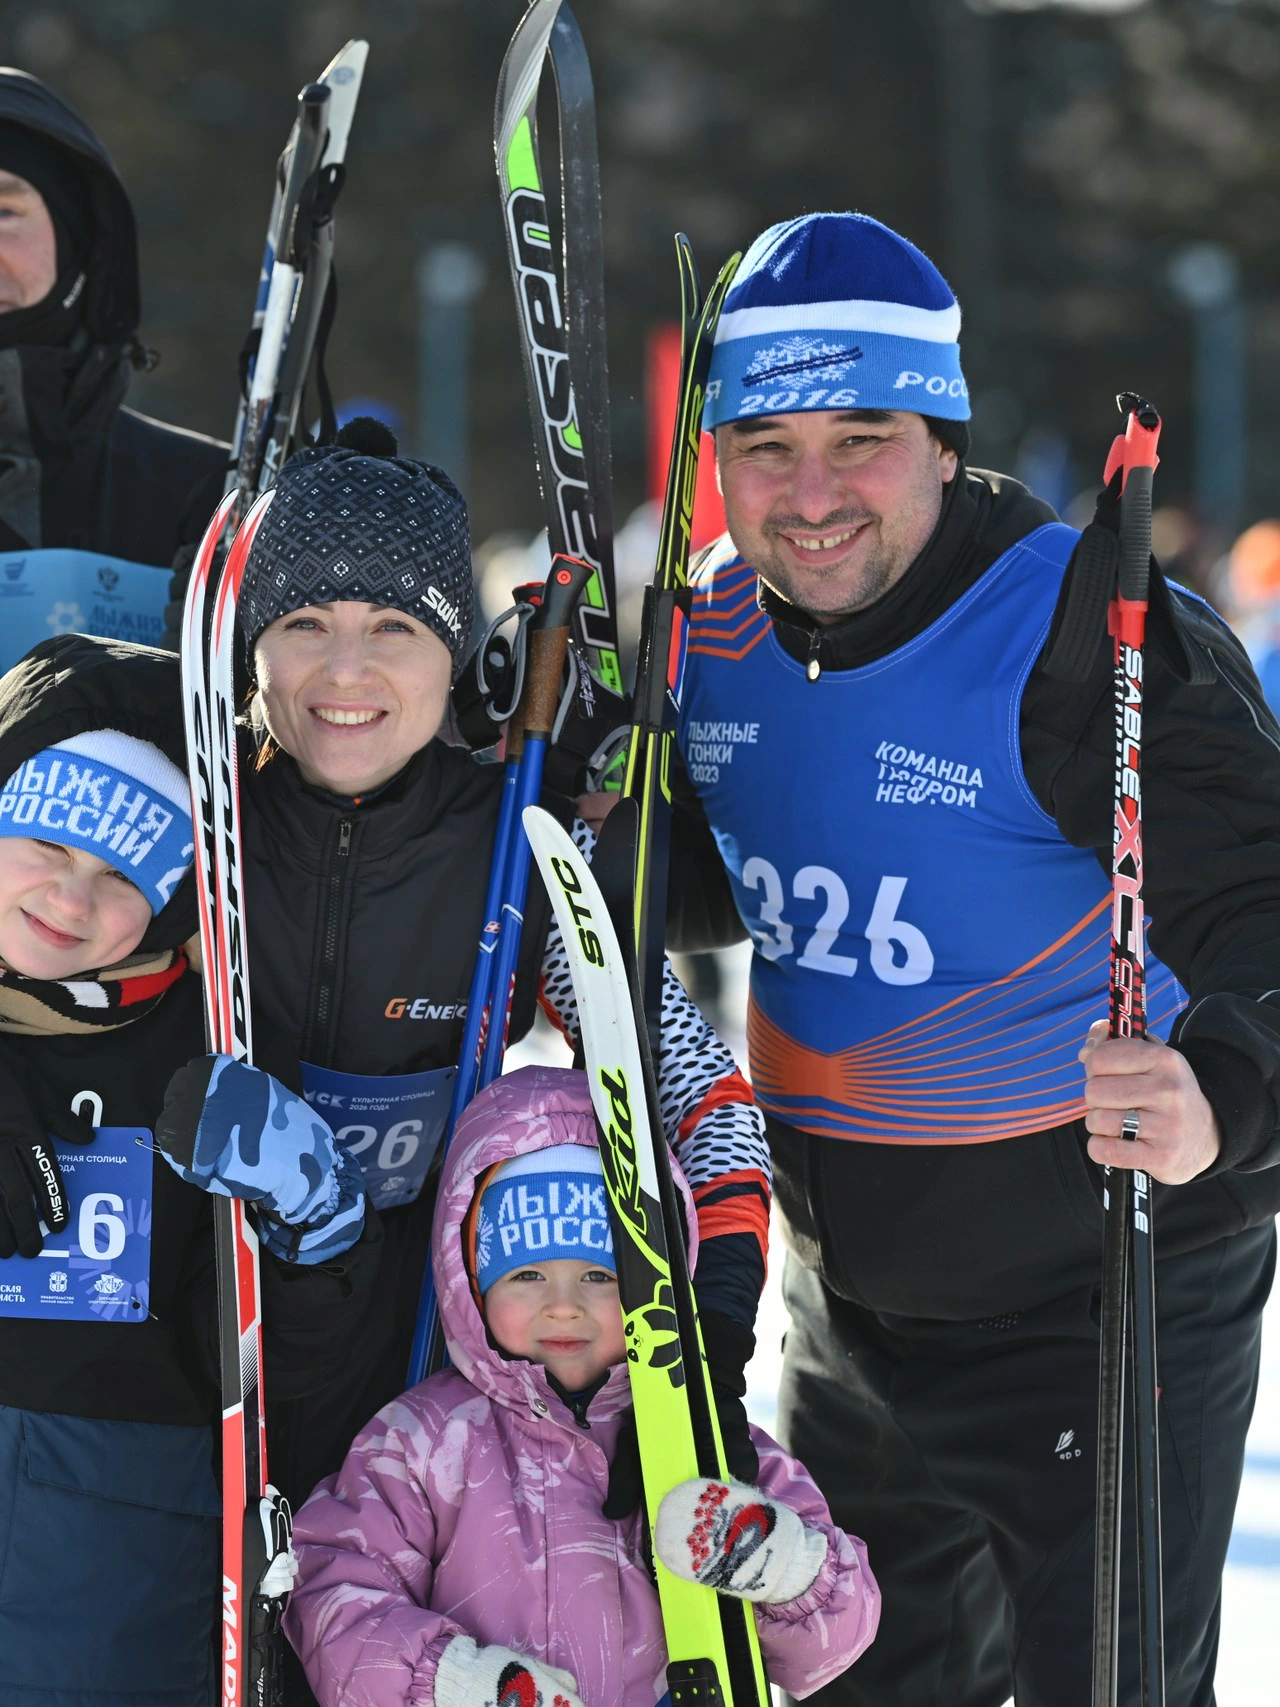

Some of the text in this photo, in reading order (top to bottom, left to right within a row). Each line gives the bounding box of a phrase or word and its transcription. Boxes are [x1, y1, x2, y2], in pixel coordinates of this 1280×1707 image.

[738, 389, 859, 416] 2016
[688, 721, 760, 743] ЛЫЖНЫЕ
[1121, 645, 1143, 801] SABLE
[688, 743, 733, 764] ГОНКИ
[691, 763, 719, 784] 2023
[875, 740, 983, 788] КОМАНДА
[4, 758, 174, 843] ЛЫЖНЯ
[742, 855, 935, 987] 326
[351, 1090, 435, 1104] КУЛЬТУРНАЯ СТОЛИЦА
[56, 1154, 128, 1164] УРНАЯ СТОЛИЦА
[336, 1119, 423, 1173] 26
[32, 1145, 64, 1223] NORDSKI
[497, 1182, 608, 1226] ЛЫЖ
[1134, 1169, 1149, 1234] BLE
[499, 1216, 613, 1257] РОСС
